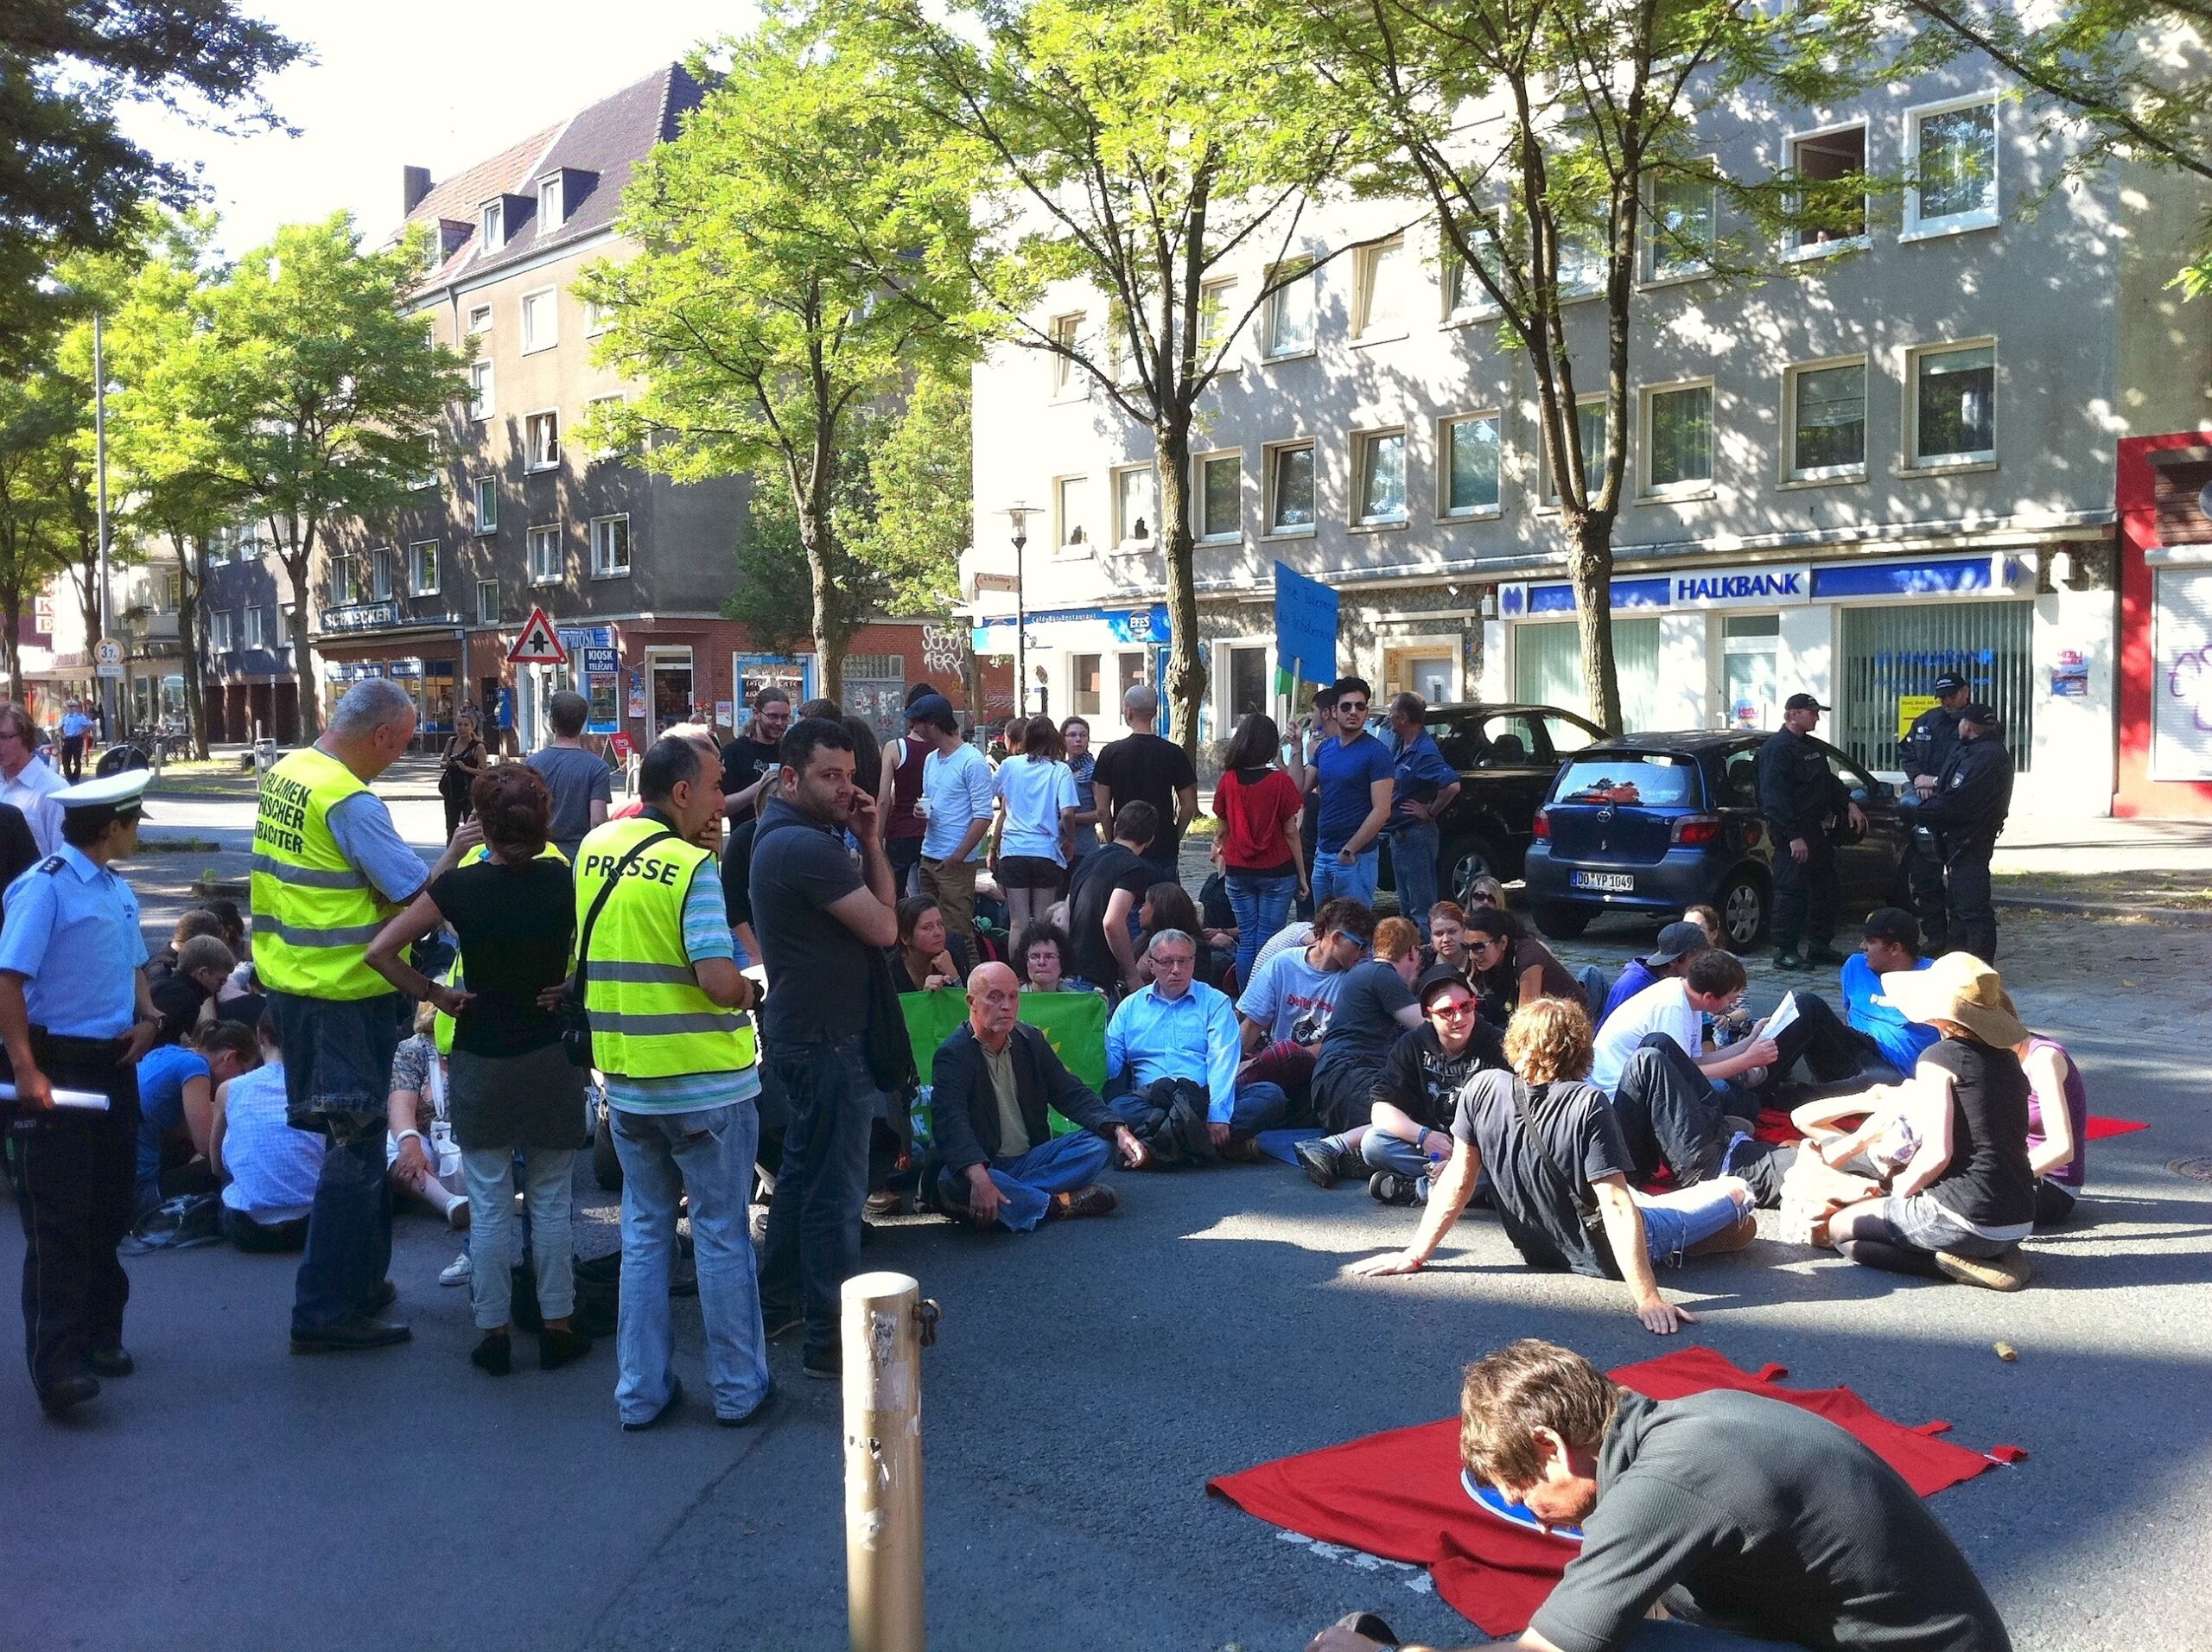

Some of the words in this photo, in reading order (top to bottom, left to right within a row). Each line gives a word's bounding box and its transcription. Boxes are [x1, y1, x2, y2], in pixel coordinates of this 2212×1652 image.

[1678, 573, 1801, 600] HALKBANK
[325, 607, 391, 627] SCHLECKER
[1129, 615, 1151, 625] EFES
[588, 649, 613, 661] KIOSK
[1577, 872, 1589, 886] DO
[1596, 874, 1608, 886] YP
[1609, 875, 1633, 888] 1049
